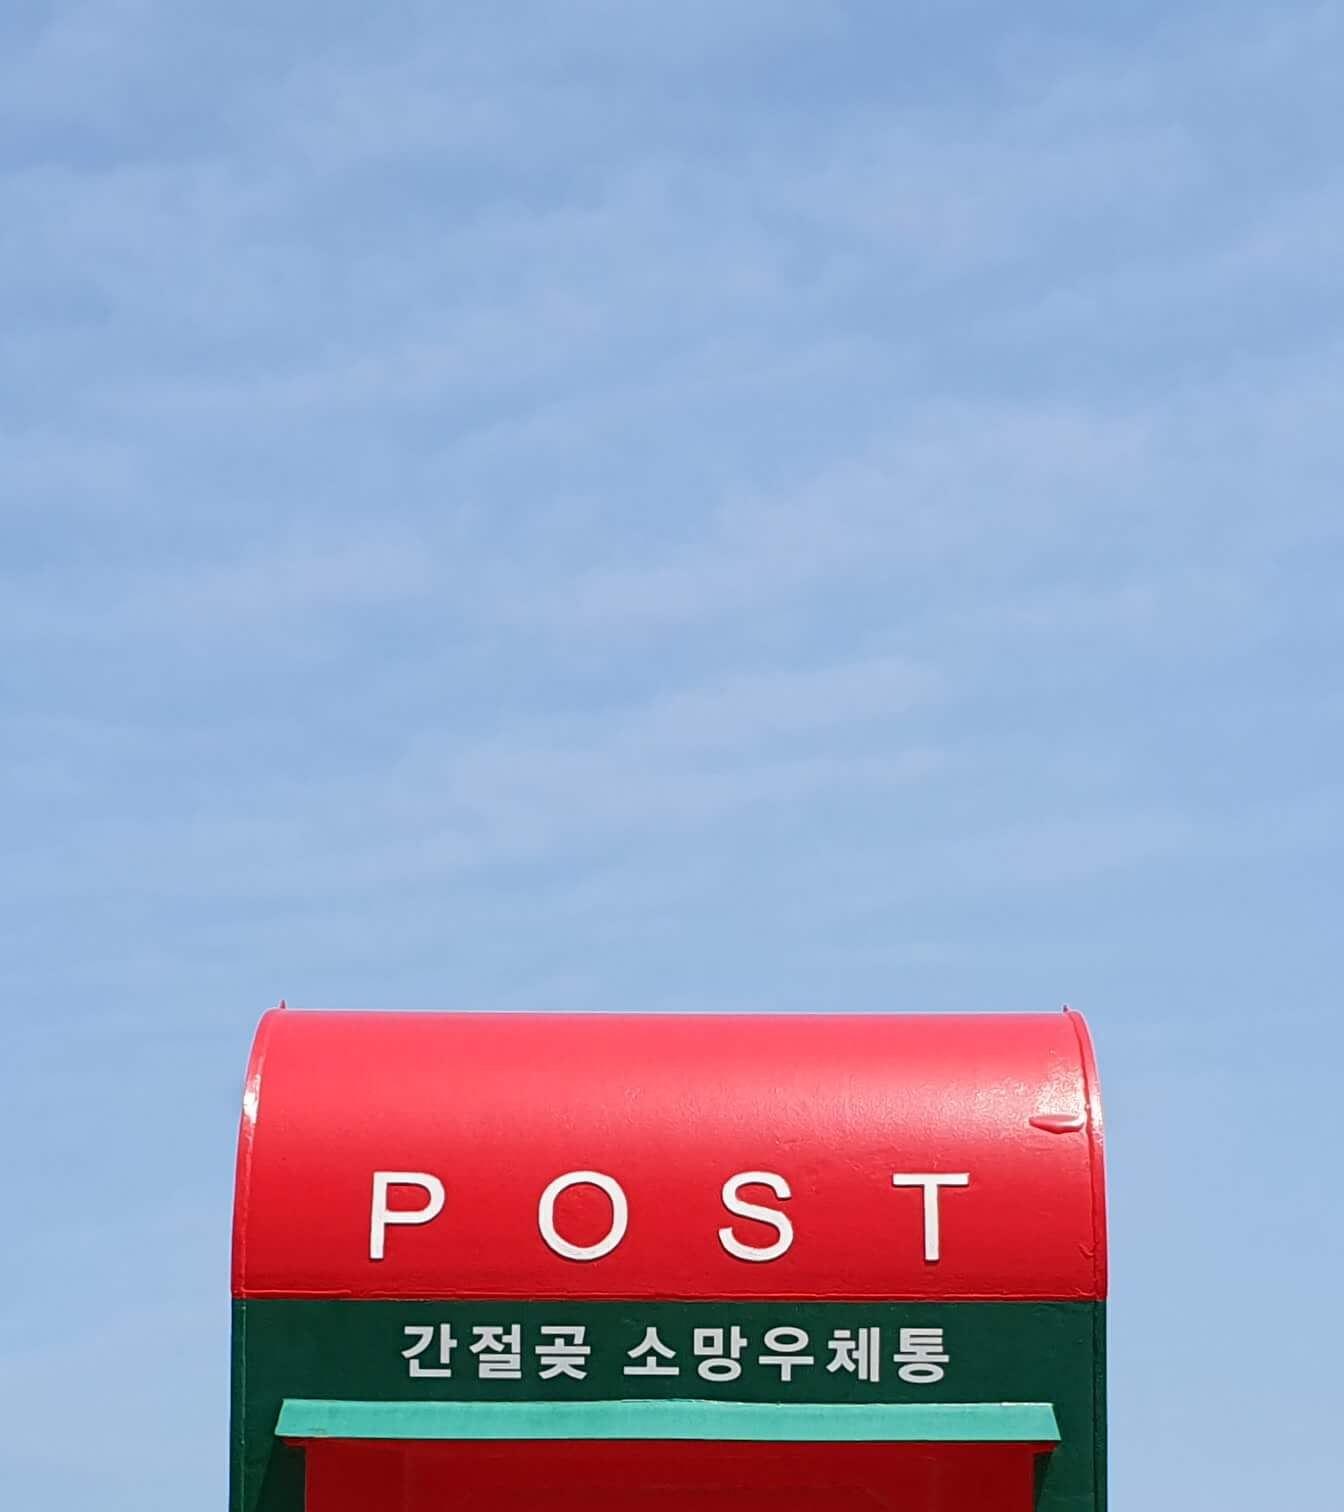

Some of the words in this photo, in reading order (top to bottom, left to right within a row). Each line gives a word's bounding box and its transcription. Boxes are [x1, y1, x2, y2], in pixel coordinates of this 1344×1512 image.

[369, 1169, 970, 1262] POST
[401, 1323, 592, 1381] 간절곶
[623, 1325, 951, 1384] 소망우체통
